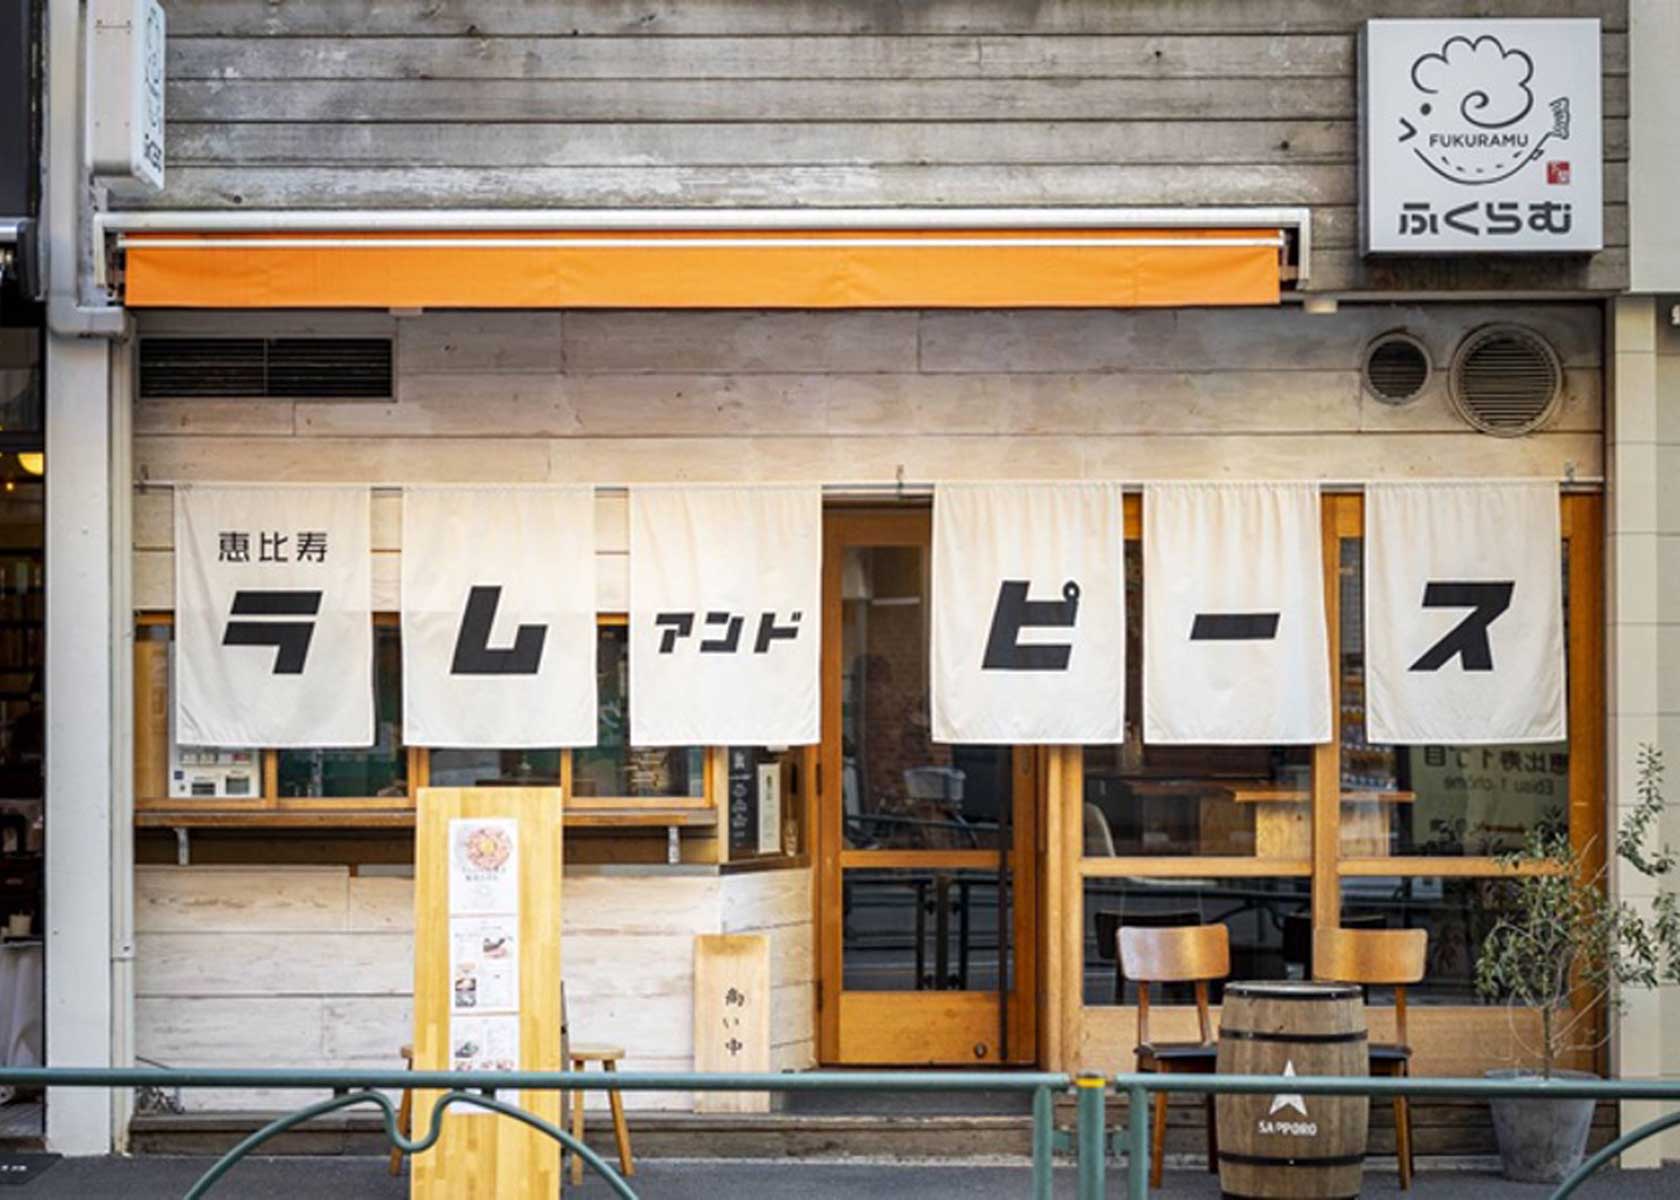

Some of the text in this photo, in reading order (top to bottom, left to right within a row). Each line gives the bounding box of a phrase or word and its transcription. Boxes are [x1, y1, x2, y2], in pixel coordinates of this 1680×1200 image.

[1429, 133, 1529, 148] FUKURAMU
[1398, 201, 1572, 236] ふくらむ
[218, 531, 327, 563] 恵比寿
